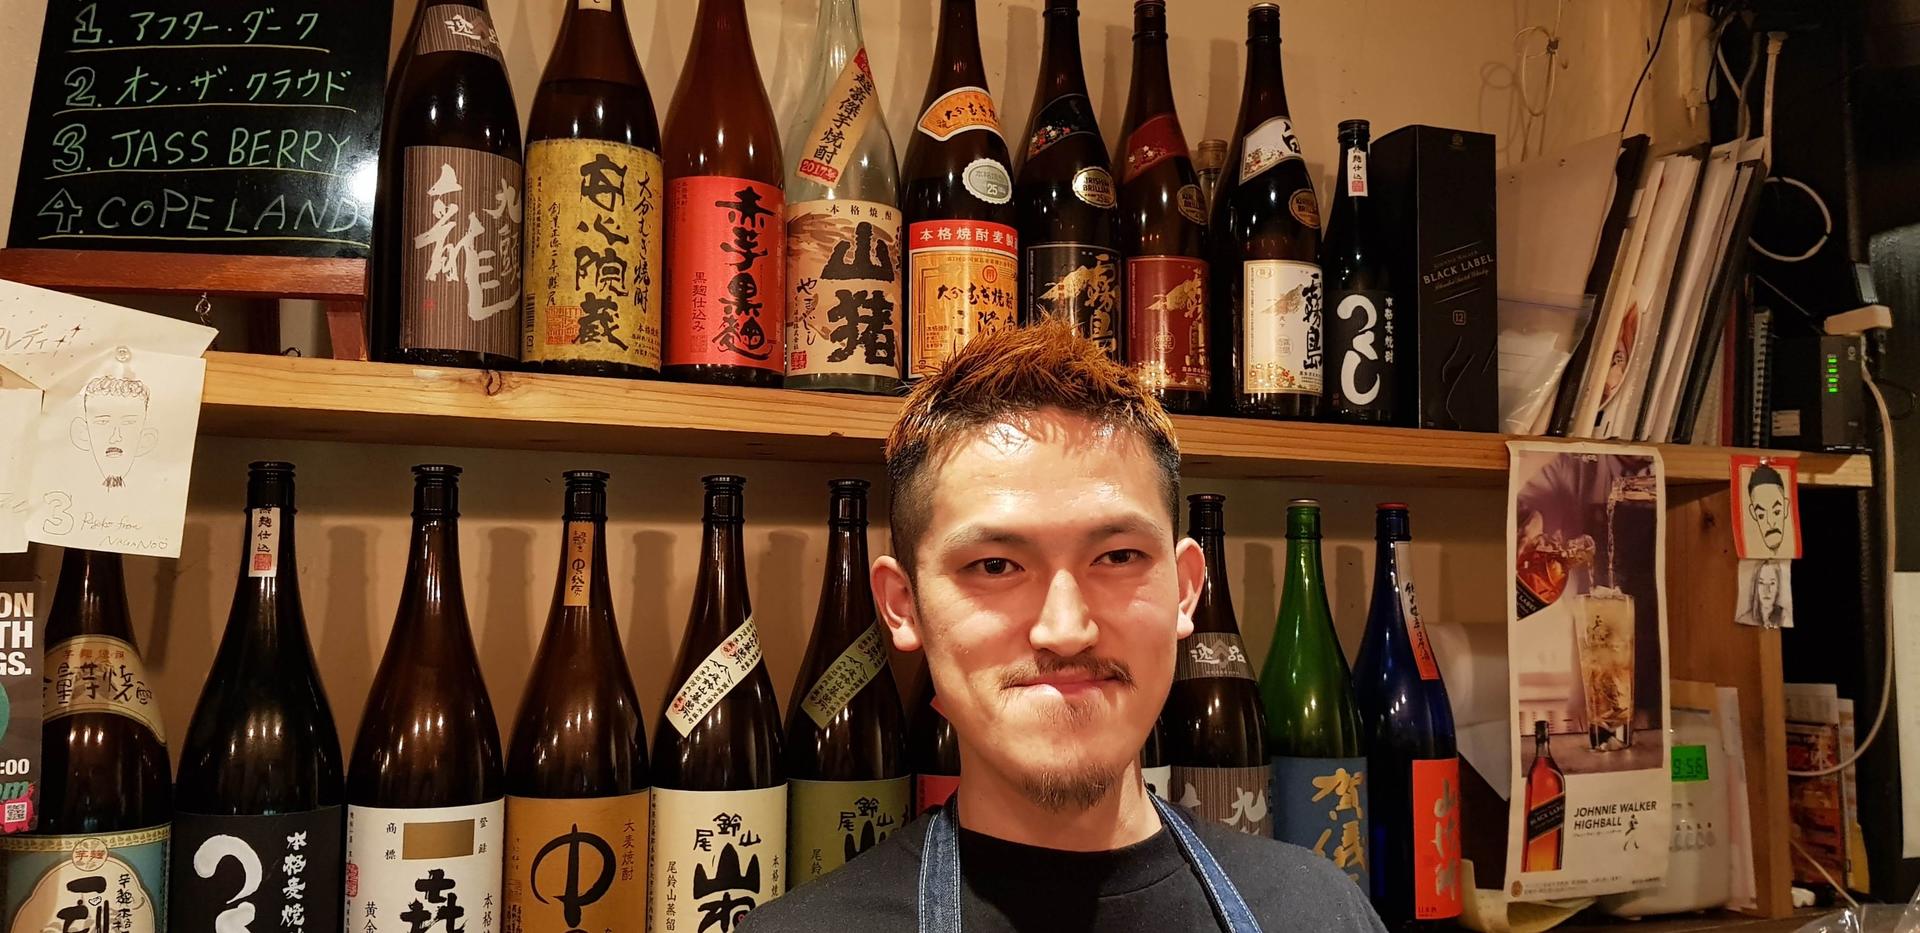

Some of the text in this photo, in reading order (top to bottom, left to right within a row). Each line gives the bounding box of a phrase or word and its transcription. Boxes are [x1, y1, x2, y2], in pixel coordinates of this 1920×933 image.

[108, 128, 209, 168] JASS
[228, 127, 350, 169] BERRY
[829, 204, 892, 220] 本格焼酎
[1423, 266, 1458, 285] BLACK
[1461, 254, 1494, 271] LABEL
[1573, 800, 1658, 818] JOHNNIE WALKER
[1573, 817, 1622, 831] HIGHBALL
[621, 820, 636, 881] 大麦焼酎
[280, 830, 307, 933] 本格麦焼
